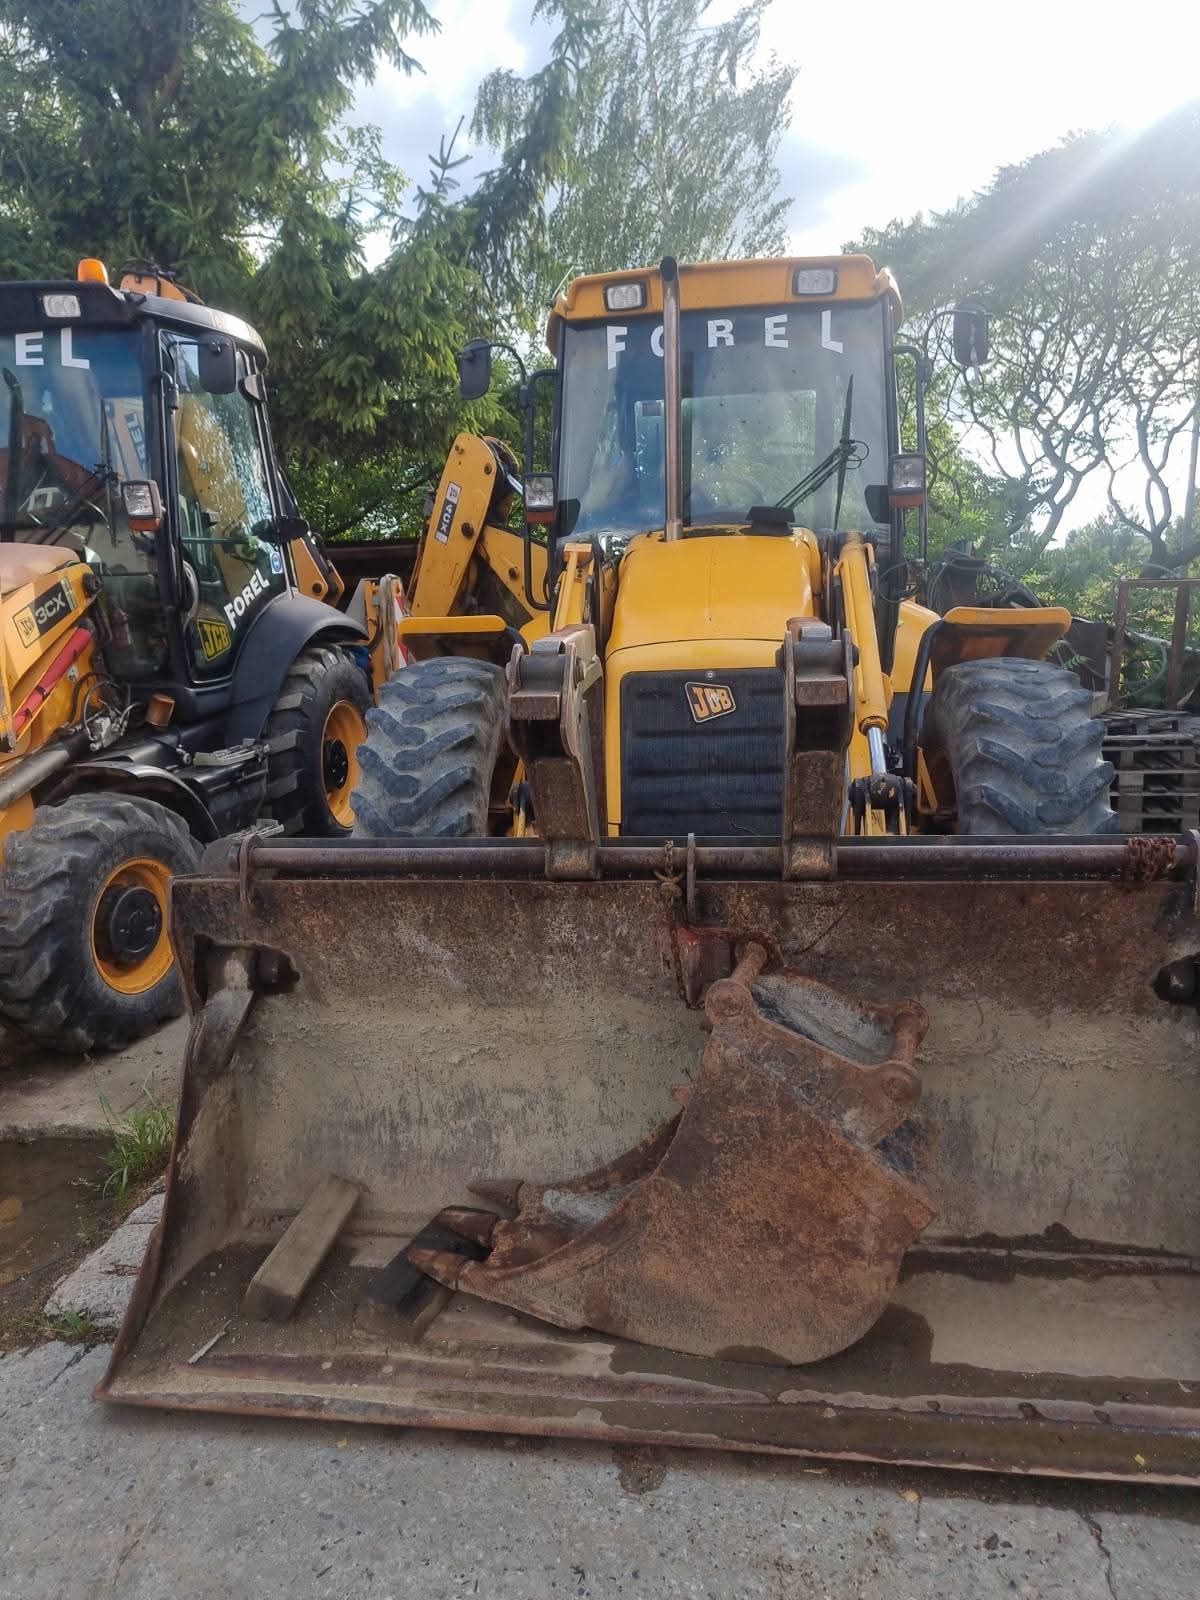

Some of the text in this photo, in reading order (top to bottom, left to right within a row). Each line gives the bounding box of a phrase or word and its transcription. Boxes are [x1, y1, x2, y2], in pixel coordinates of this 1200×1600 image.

[15, 327, 90, 369] EL
[35, 592, 66, 625] 3CX
[223, 568, 271, 630] FOREL
[202, 622, 230, 657] JCB
[691, 686, 732, 718] JCB
